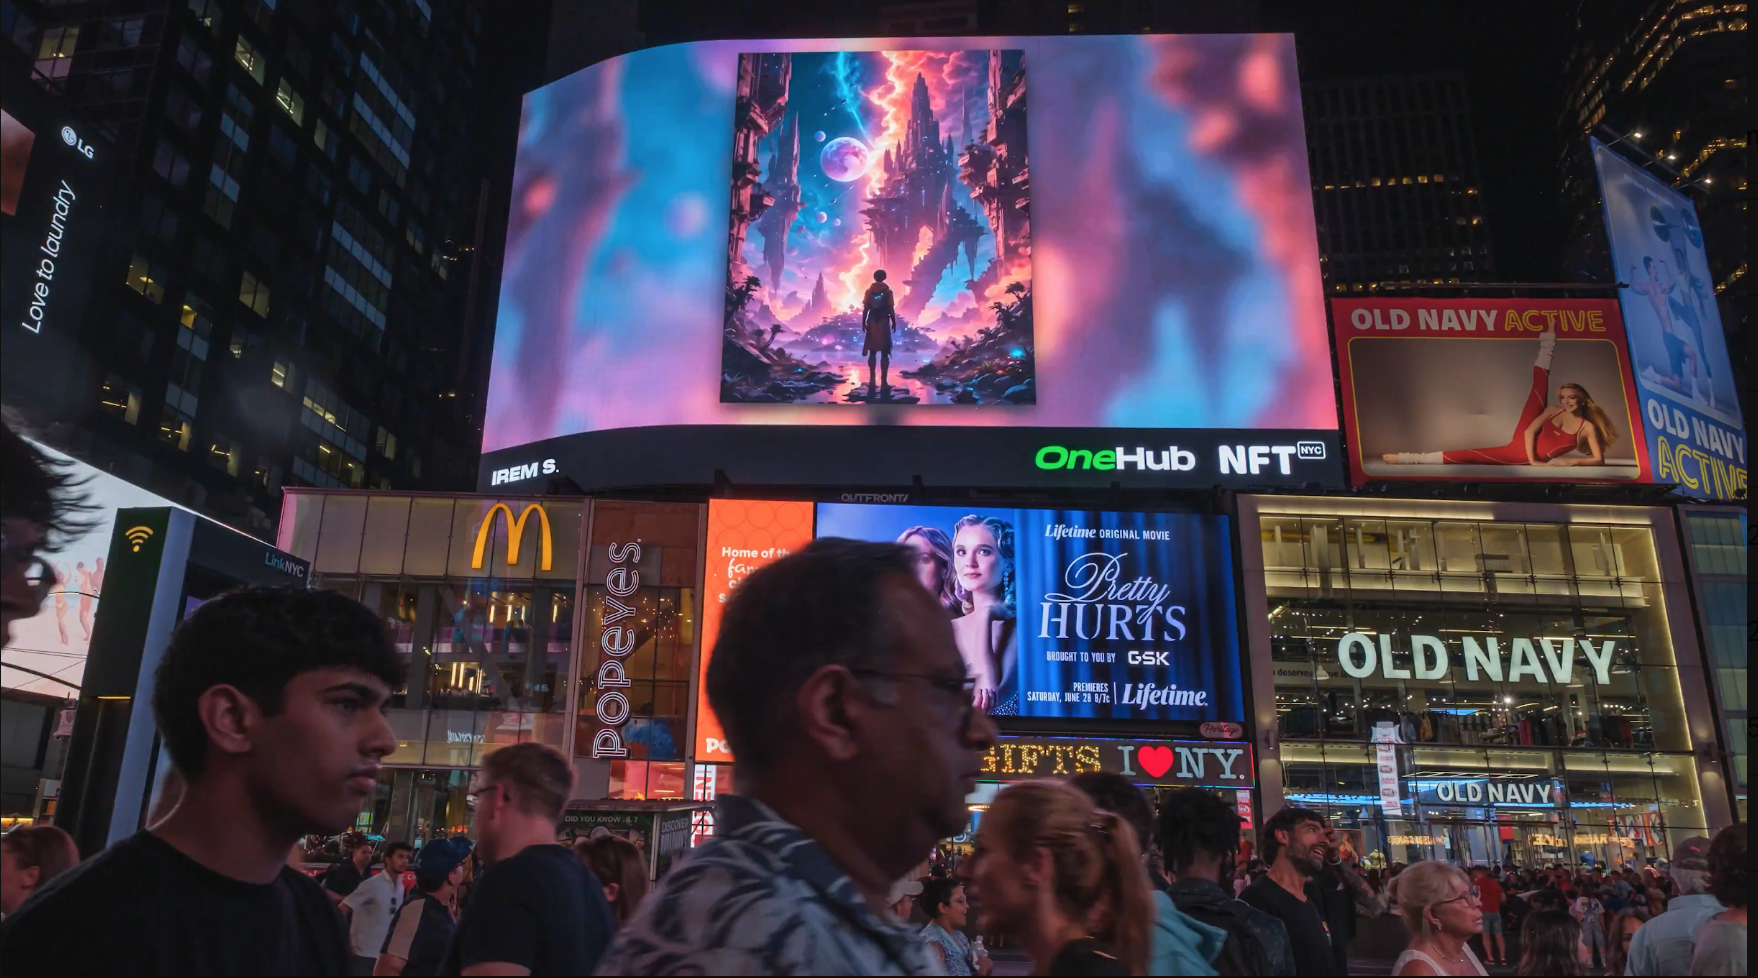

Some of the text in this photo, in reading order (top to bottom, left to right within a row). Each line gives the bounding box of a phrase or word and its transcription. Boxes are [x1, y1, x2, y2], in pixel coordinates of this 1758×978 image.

[77, 138, 95, 159] LG
[21, 179, 76, 334] Love to laundry
[1351, 308, 1607, 332] OLD NAVY ACTIVE
[1647, 398, 1745, 465] OLD NAVY
[491, 458, 560, 486] IREM S.
[1035, 445, 1322, 475] OneHub NFT NYC
[1045, 524, 1170, 541] Lifetime ORIGINAL MOVIE
[264, 551, 305, 578] LinkNYC
[721, 546, 758, 558] Home
[760, 548, 775, 559] of
[1044, 552, 1171, 625] Pretty
[1037, 601, 1186, 642] HURTS
[1046, 650, 1171, 666] BROUGHT TO YOU BY GSK
[1338, 632, 1616, 685] OLD NAVY
[1027, 691, 1111, 704] SATURDAY, JUNE 28 8/7c
[1073, 682, 1109, 693] PREMIERES
[1203, 723, 1239, 737] Heritage
[1117, 745, 1136, 777] I
[1436, 782, 1551, 804] OLD NAVY
[580, 815, 596, 823] YOU
[597, 815, 622, 823] KNOW
